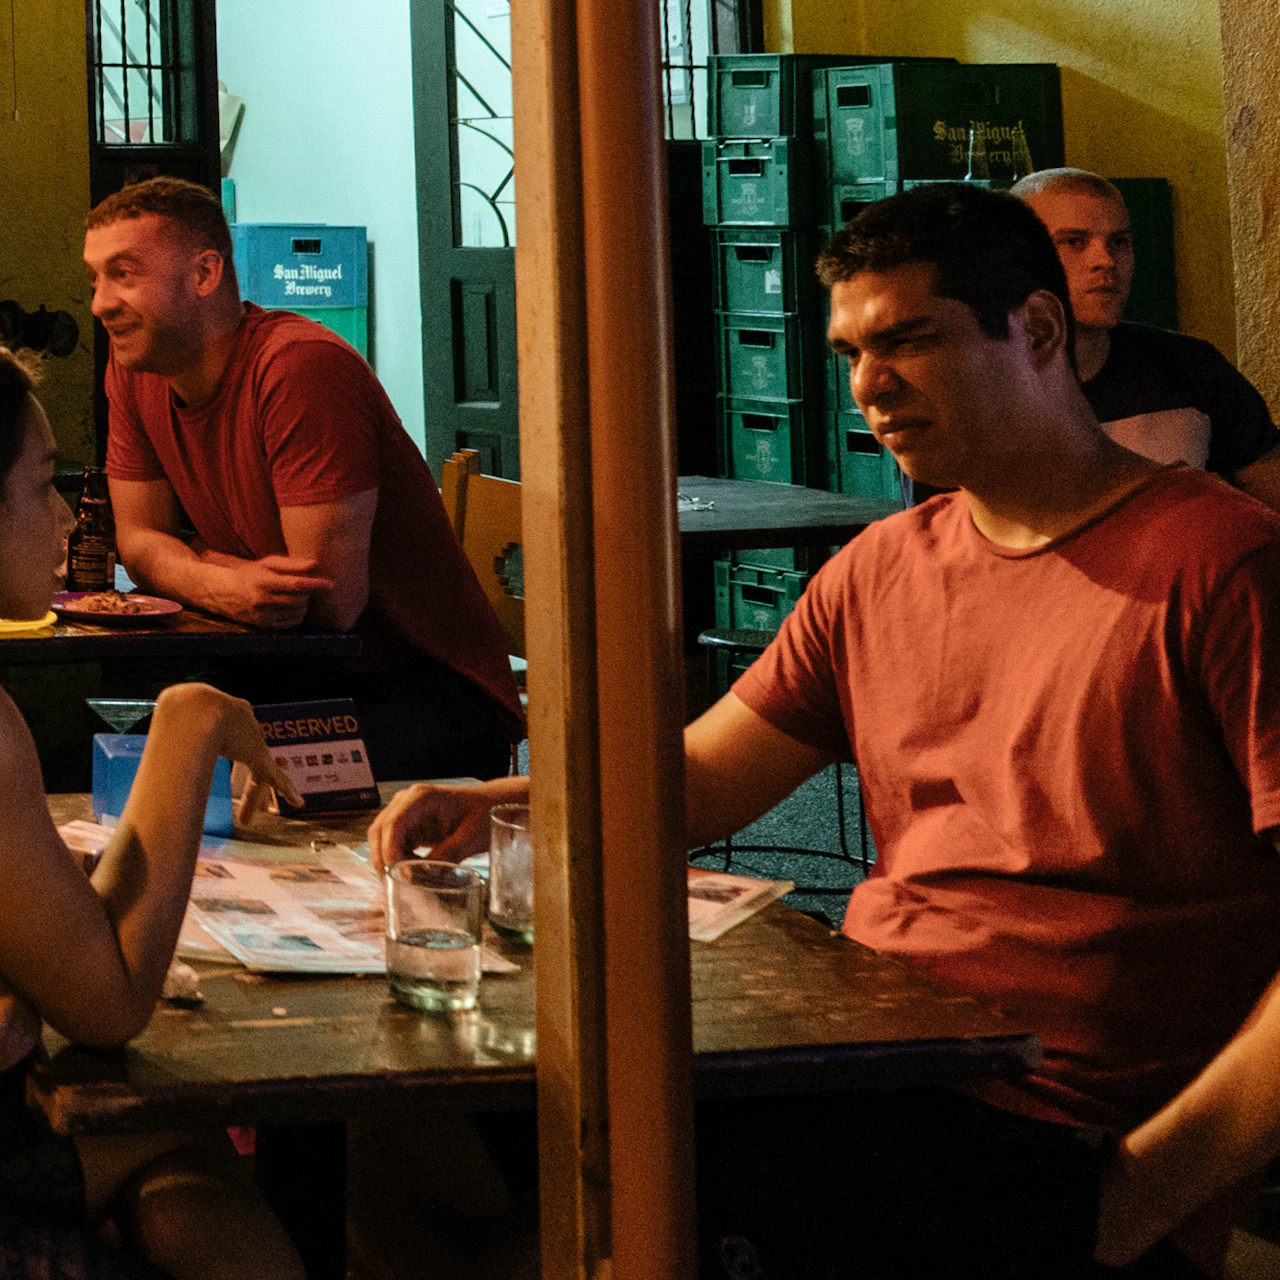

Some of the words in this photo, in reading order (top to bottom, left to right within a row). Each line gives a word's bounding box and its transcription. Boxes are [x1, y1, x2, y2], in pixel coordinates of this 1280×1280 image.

[933, 120, 967, 141] San
[273, 263, 299, 280] San
[299, 263, 343, 282] Miguel
[284, 280, 333, 298] Brewery
[261, 714, 360, 740] RESERVED
